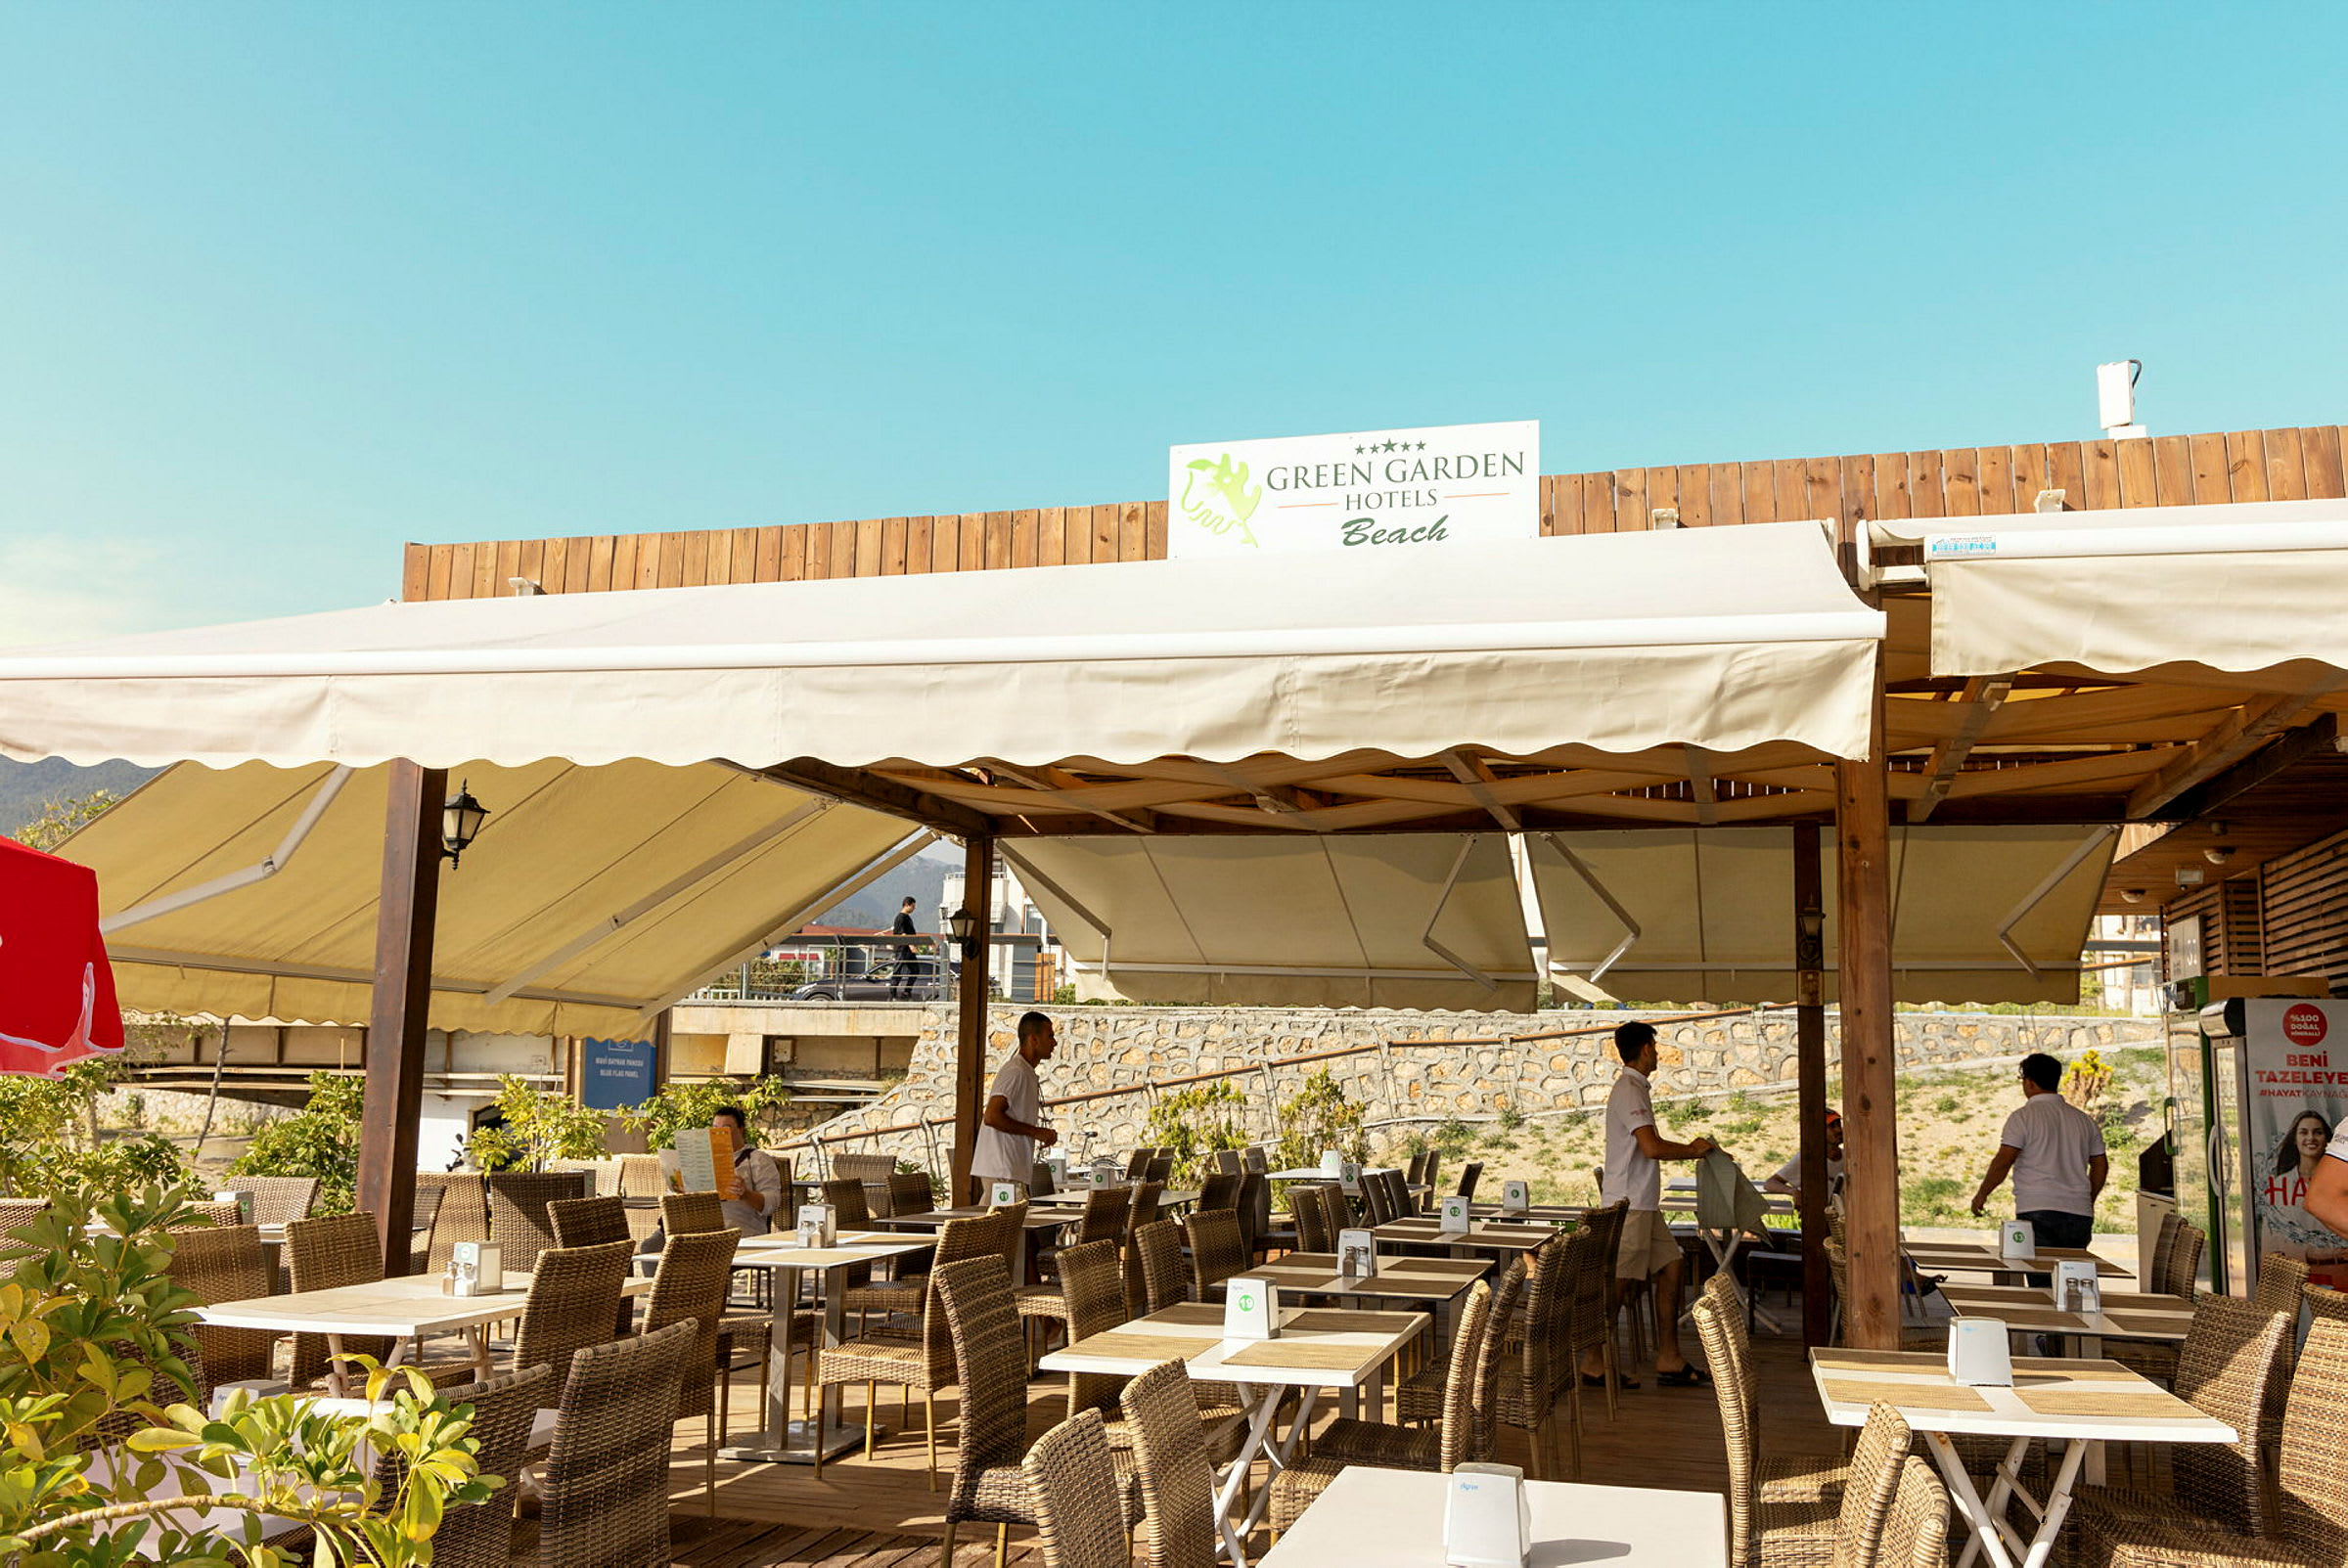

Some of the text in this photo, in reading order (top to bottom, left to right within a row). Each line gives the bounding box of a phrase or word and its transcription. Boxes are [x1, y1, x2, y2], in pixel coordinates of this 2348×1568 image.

[1266, 451, 1525, 491] GREEN GARDEN
[1344, 488, 1438, 512] HOTELS
[1340, 515, 1450, 547] Beach
[2286, 1051, 2328, 1067] BENİ
